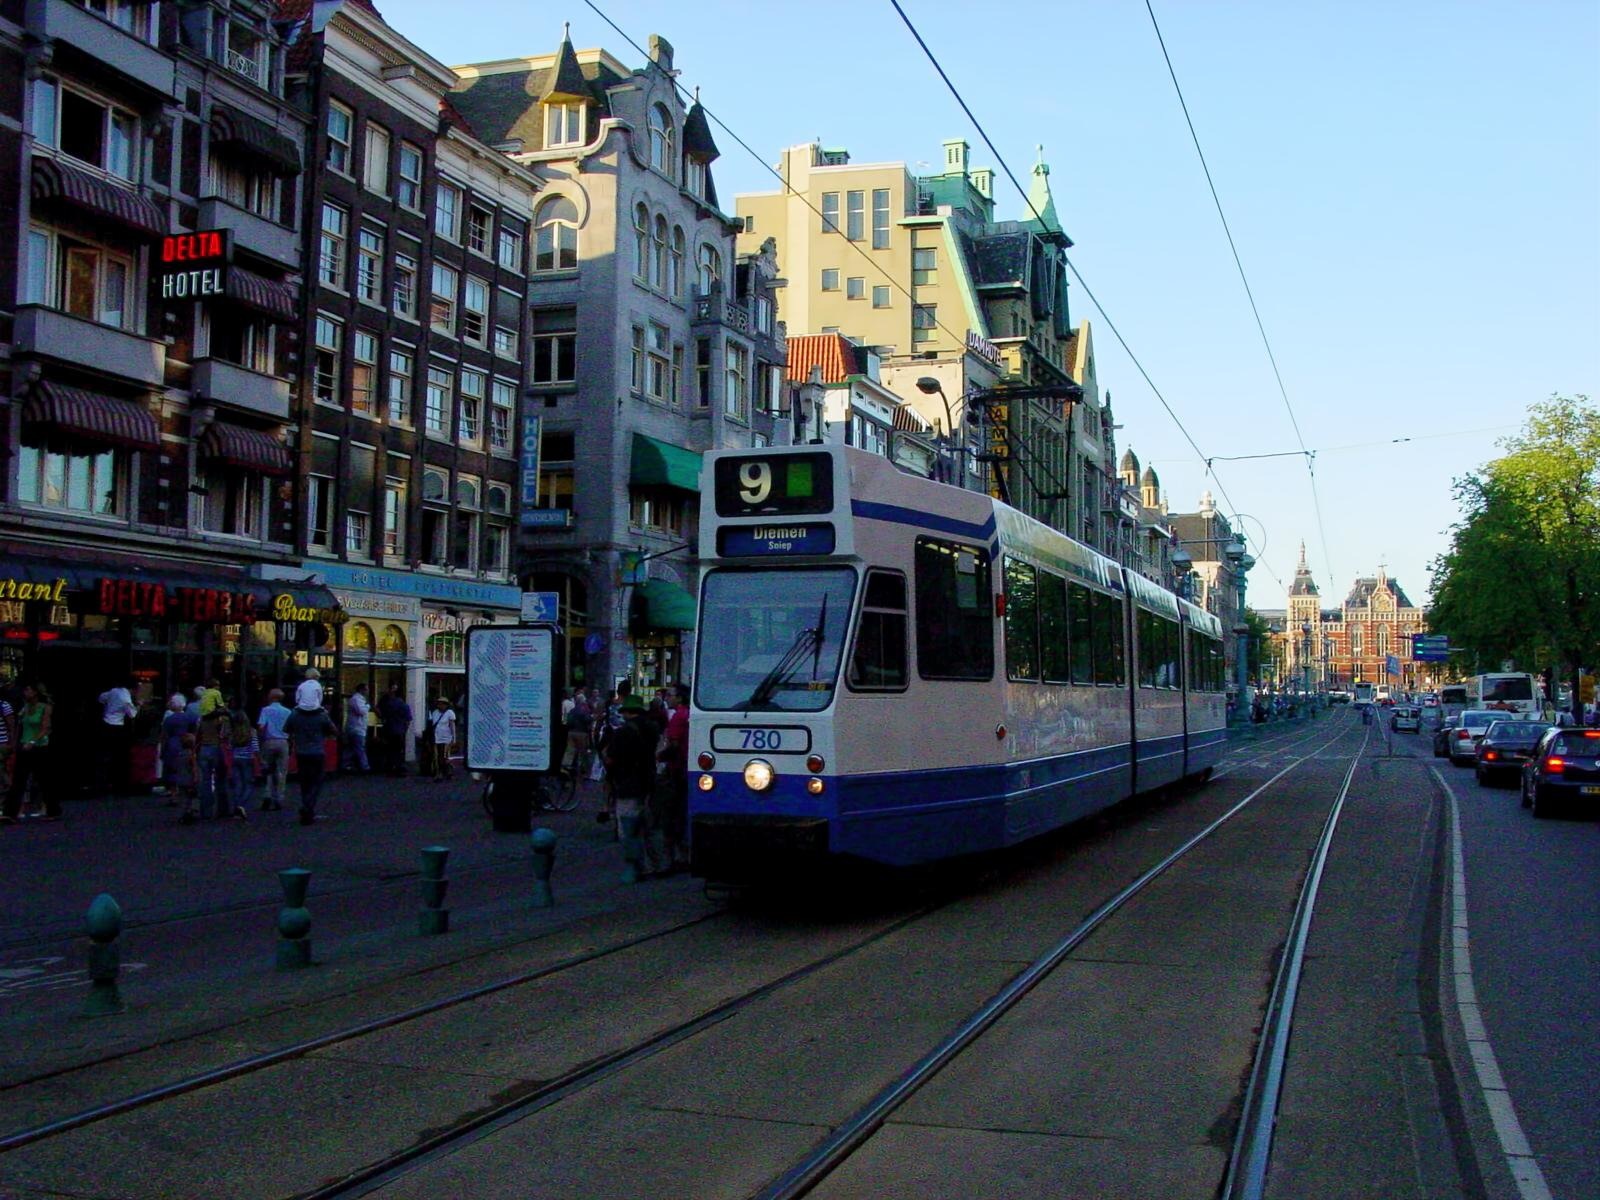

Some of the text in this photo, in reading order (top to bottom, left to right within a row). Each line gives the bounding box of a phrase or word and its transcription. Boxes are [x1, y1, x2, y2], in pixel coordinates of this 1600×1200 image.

[163, 232, 222, 262] DELTA
[162, 268, 224, 298] HOTEL
[522, 420, 538, 503] HOTEL
[740, 462, 771, 504] 9
[753, 527, 807, 540] Diemen
[352, 572, 392, 588] HOTEL
[739, 729, 780, 749] 780
